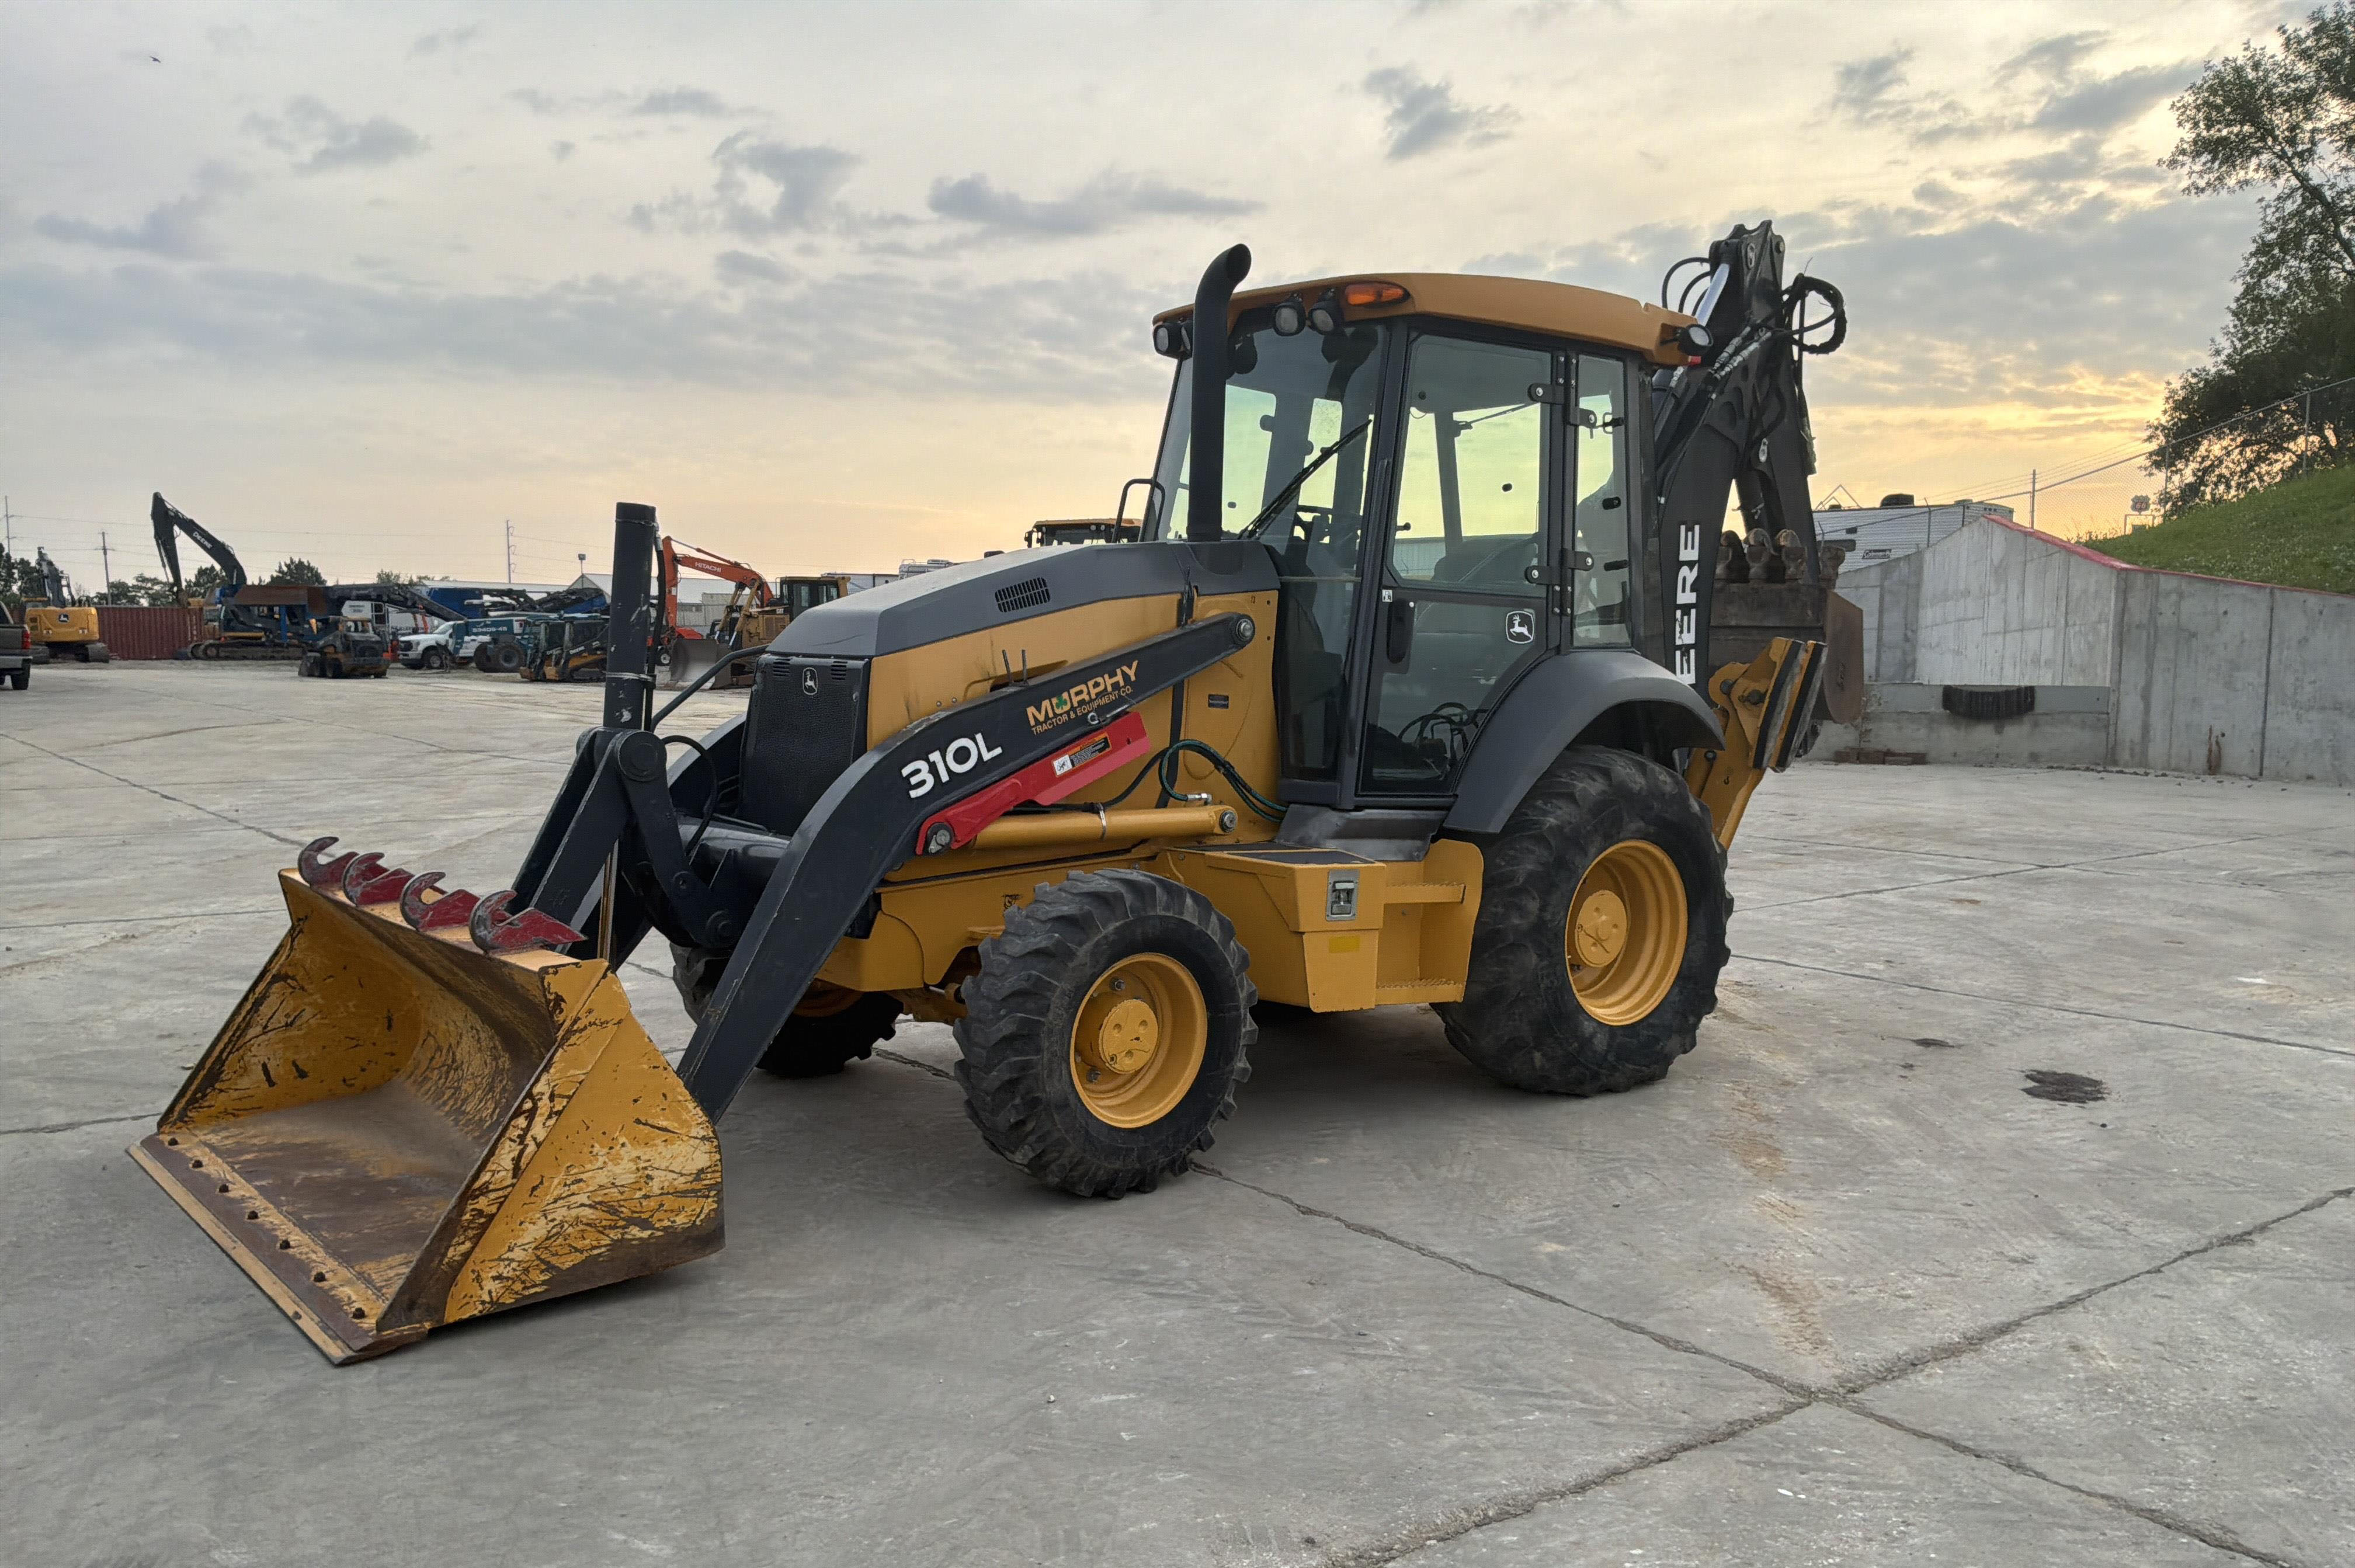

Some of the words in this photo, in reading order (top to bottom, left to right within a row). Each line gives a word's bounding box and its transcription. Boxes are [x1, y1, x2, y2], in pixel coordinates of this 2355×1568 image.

[193, 531, 213, 548] DEERE
[694, 562, 722, 572] HITACHI
[1026, 660, 1138, 726] MURPHY
[1031, 712, 1069, 735] TRACTOR
[1070, 710, 1076, 719] &
[1076, 691, 1119, 716] EQUIPMENT
[1120, 686, 1133, 696] CO.
[901, 732, 1003, 798] 310L
